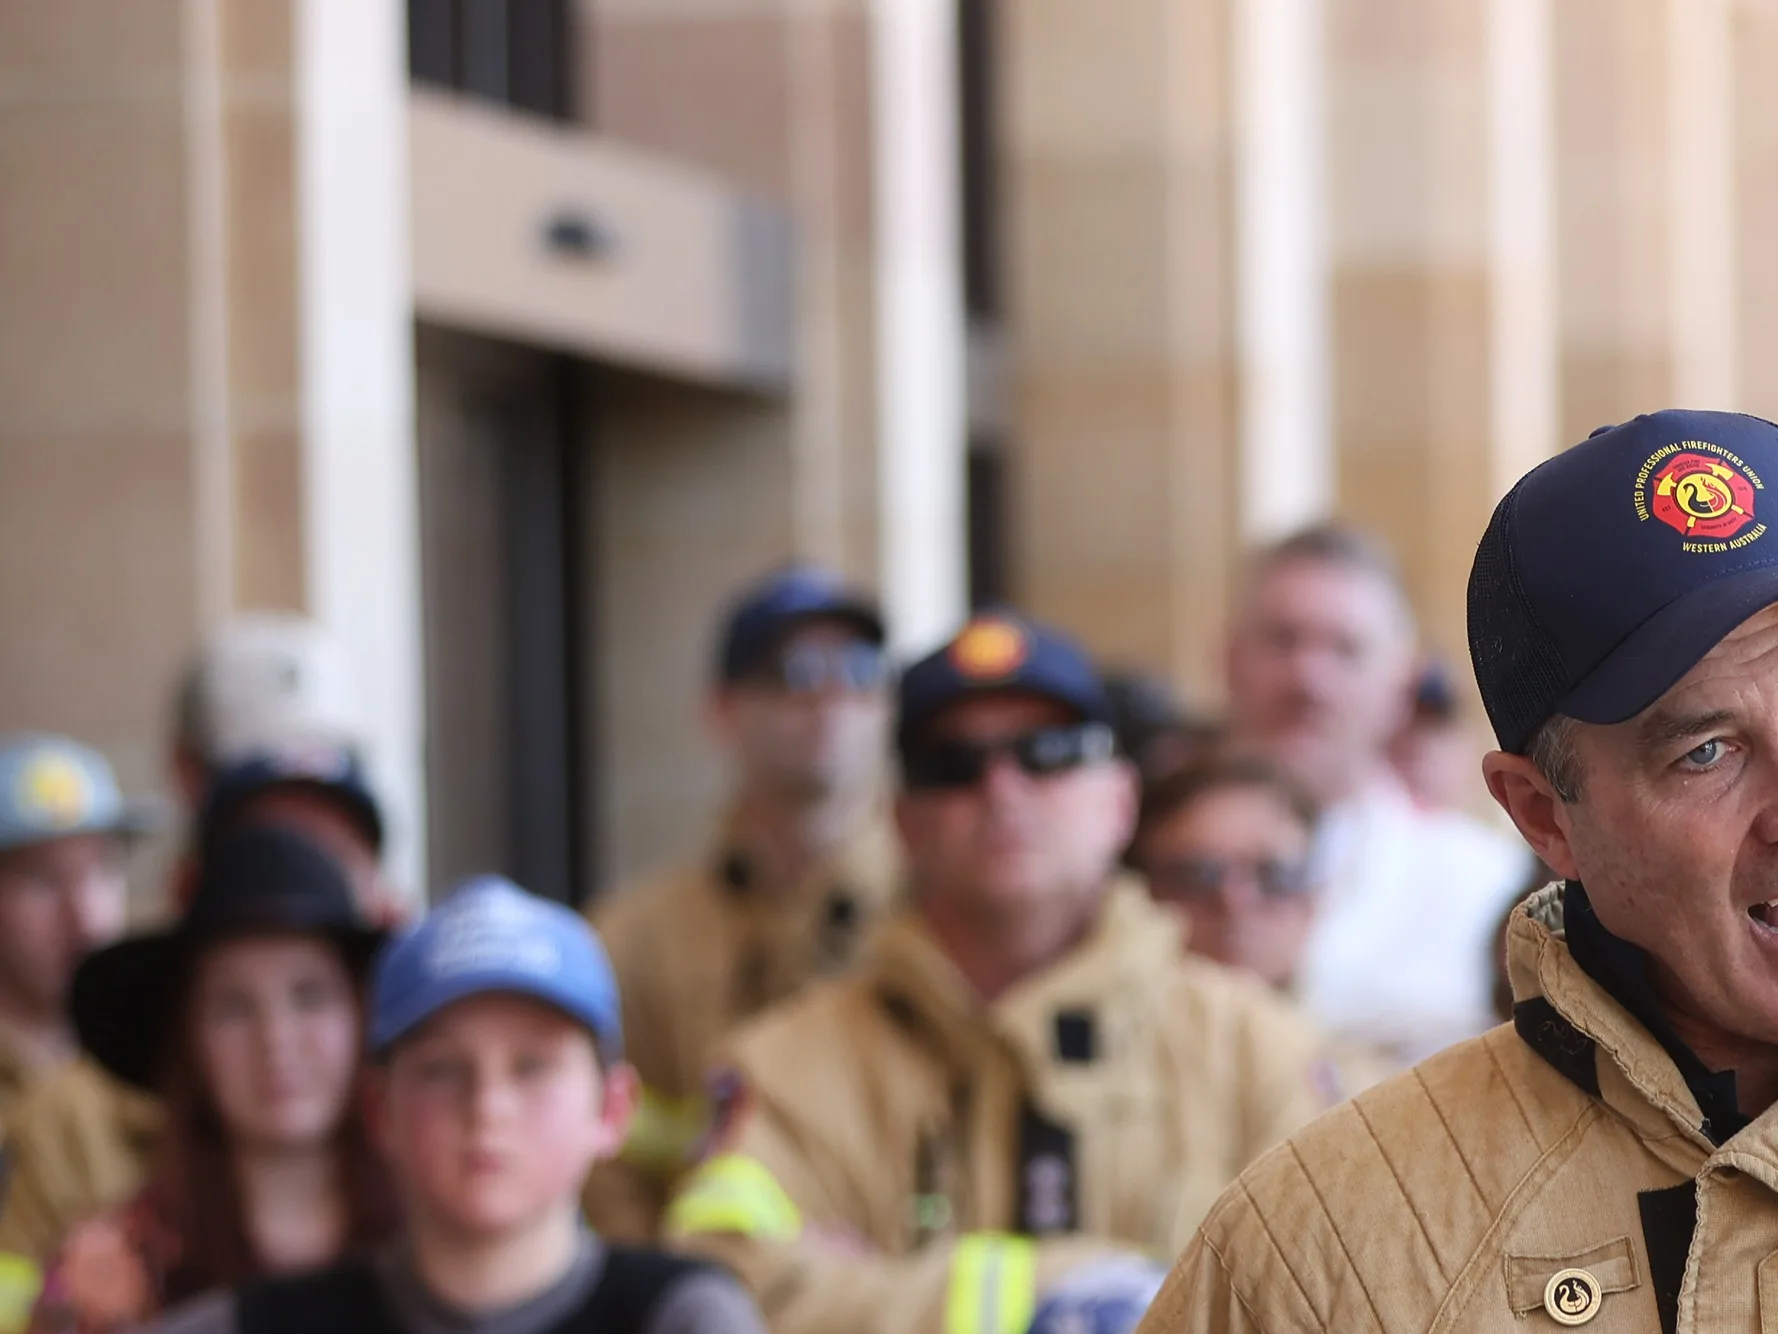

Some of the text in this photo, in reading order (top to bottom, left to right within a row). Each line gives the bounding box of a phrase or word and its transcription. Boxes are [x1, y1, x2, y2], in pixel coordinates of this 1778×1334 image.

[1635, 442, 1682, 490] PROFESSIONAL
[1682, 441, 1743, 466] FIREFIGHTERS
[1743, 466, 1764, 490] UNION
[1634, 490, 1649, 521] UNITED
[1682, 541, 1728, 553] WESTERN
[1730, 524, 1766, 549] AUSTRALIA
